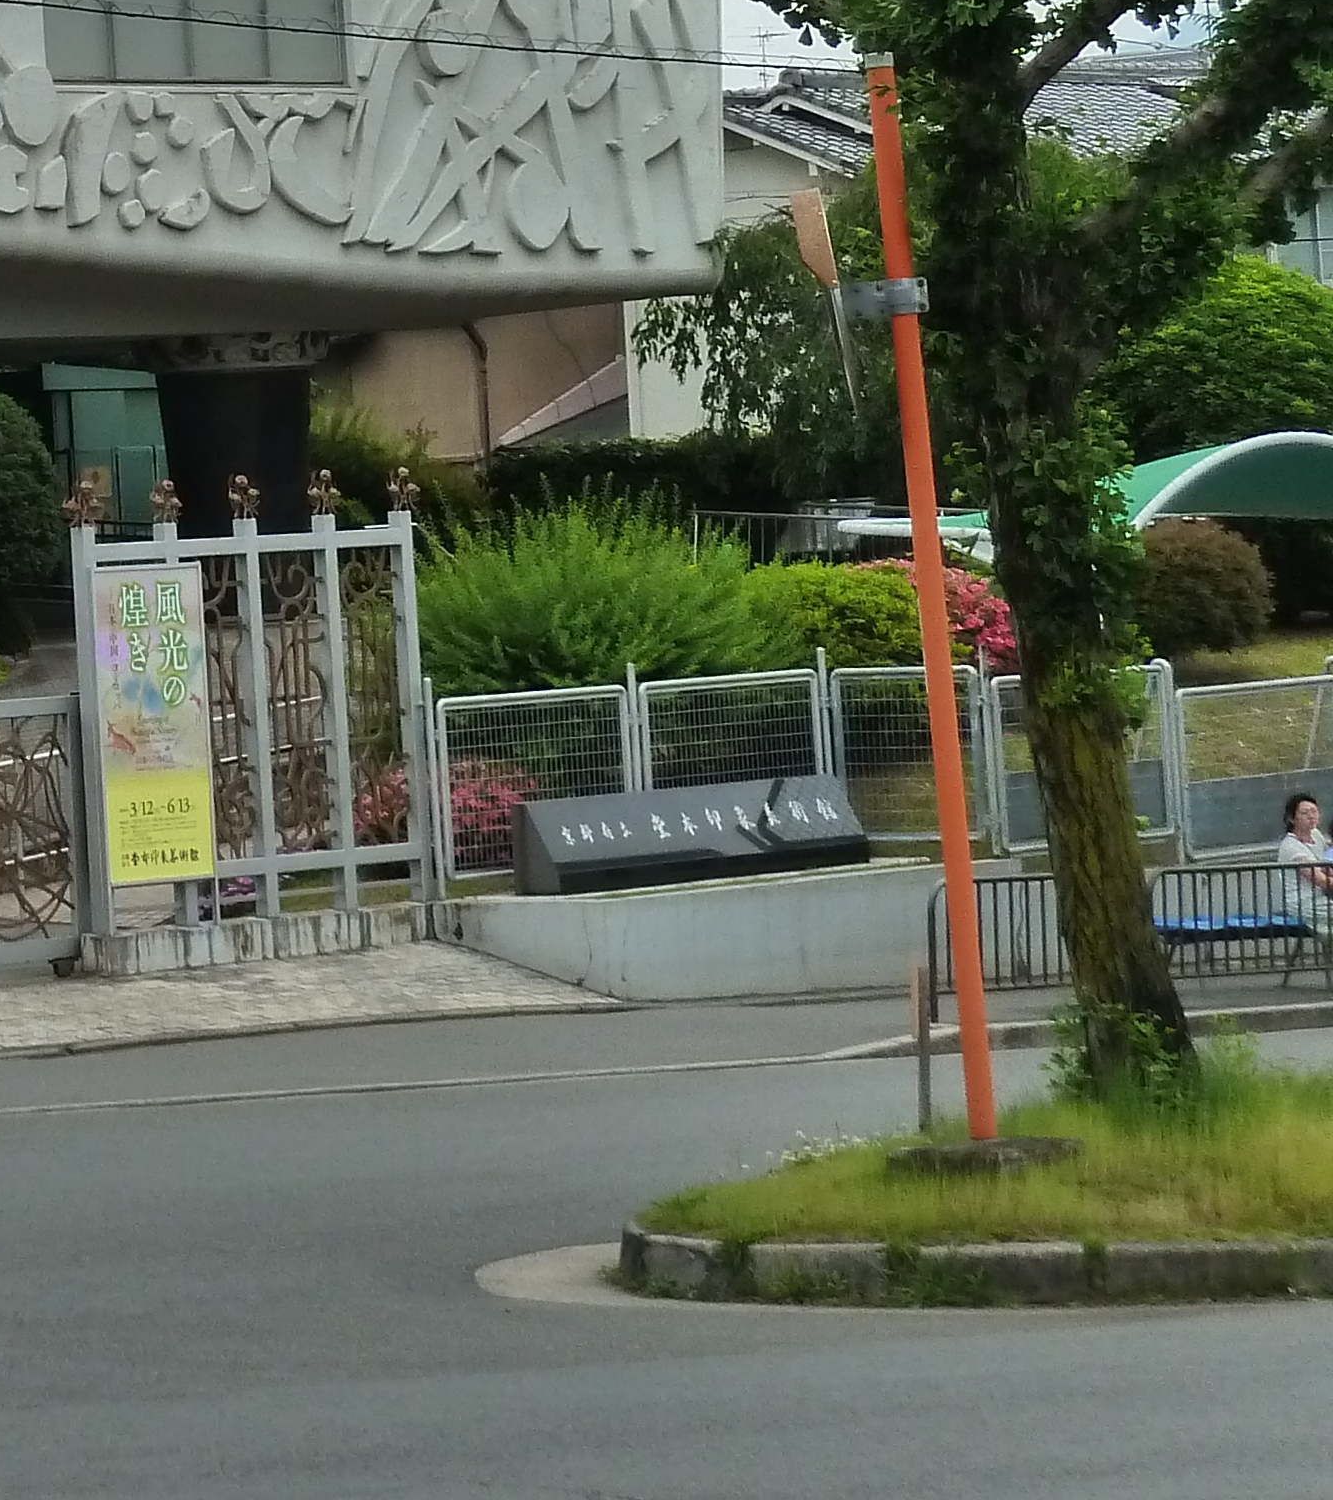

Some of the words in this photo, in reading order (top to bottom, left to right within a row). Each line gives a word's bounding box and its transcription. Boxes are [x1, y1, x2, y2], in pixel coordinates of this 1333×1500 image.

[119, 584, 150, 672] 煌き
[155, 582, 189, 706] 風光の
